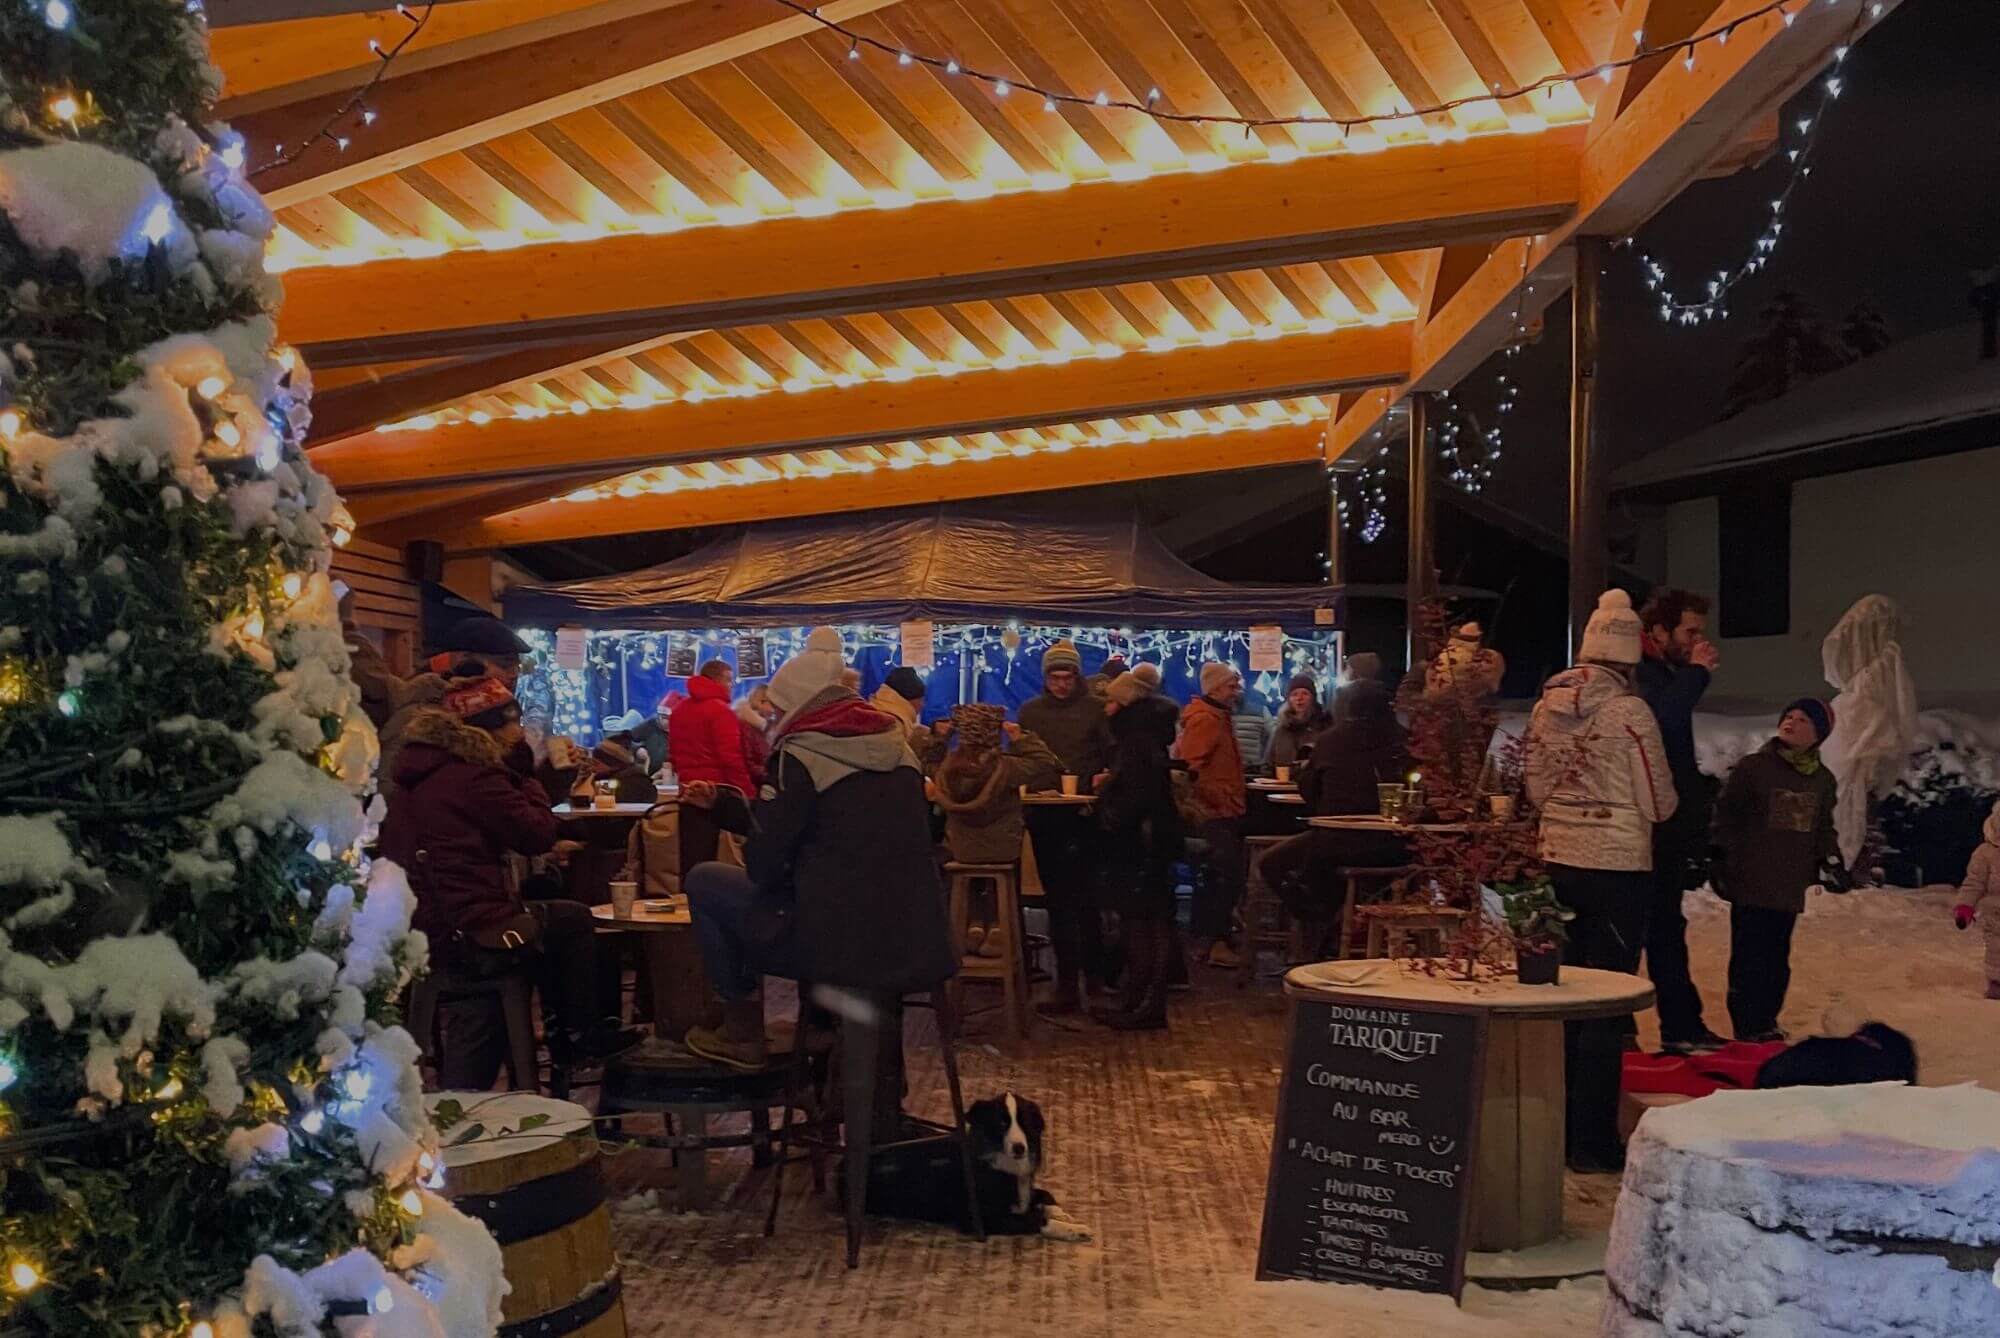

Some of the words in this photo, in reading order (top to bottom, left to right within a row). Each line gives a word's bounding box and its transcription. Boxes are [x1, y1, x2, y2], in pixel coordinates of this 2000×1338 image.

[1331, 1006, 1411, 1025] DOMAINE
[1330, 1023, 1443, 1062] TARIQUET
[1307, 1063, 1421, 1099] COMMANDE
[1332, 1101, 1358, 1121] AU
[1370, 1108, 1411, 1128] BAR
[1364, 1156, 1389, 1174] DE
[1322, 1198, 1409, 1223] ESCARGOTS
[1319, 1215, 1389, 1239] TARTINES
